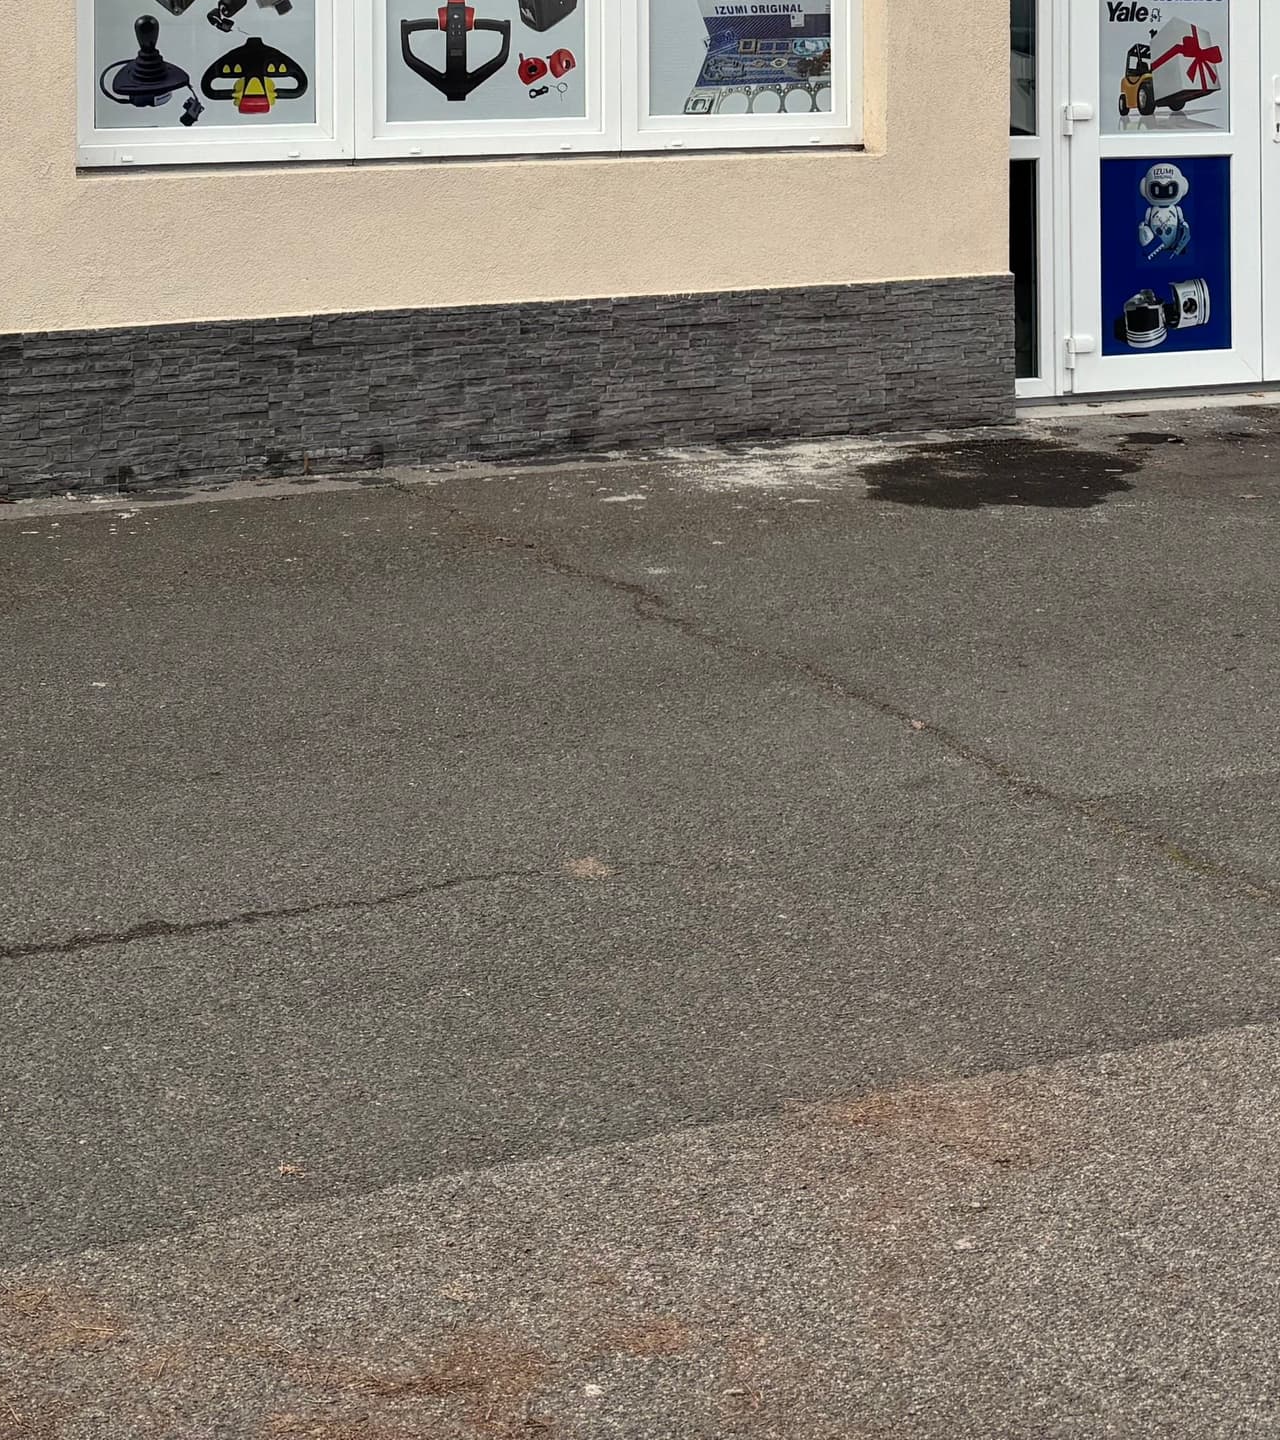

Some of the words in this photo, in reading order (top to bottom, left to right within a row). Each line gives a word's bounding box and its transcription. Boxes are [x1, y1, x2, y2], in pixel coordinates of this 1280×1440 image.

[714, 5, 748, 15] IZUMI
[751, 3, 803, 14] ORIGINAL
[1107, 2, 1149, 22] Yale
